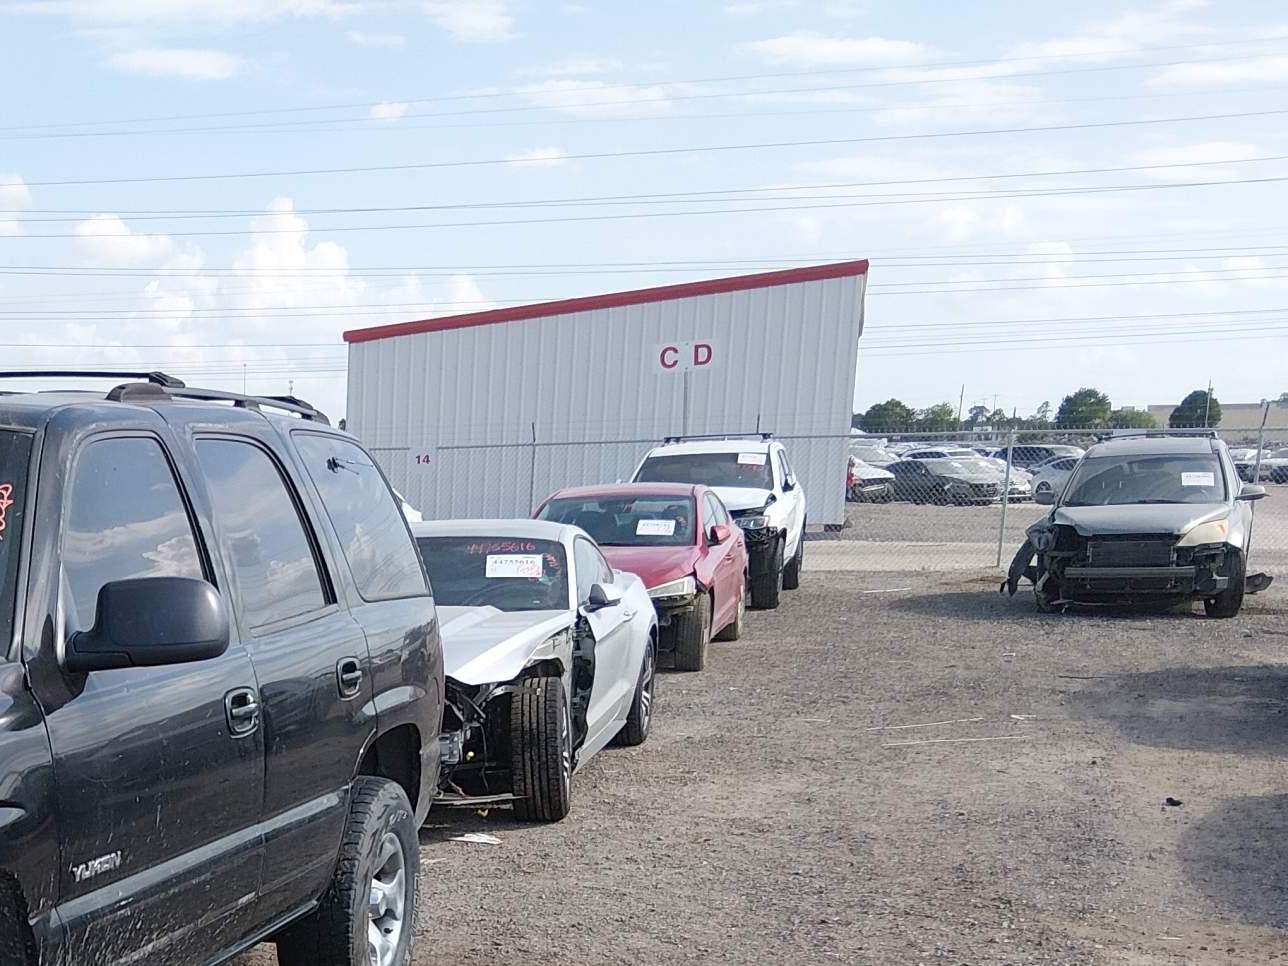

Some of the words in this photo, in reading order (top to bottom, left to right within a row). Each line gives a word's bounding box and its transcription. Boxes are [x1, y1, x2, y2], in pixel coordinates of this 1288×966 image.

[660, 346, 679, 369] C
[693, 344, 713, 366] D
[416, 455, 430, 464] 14
